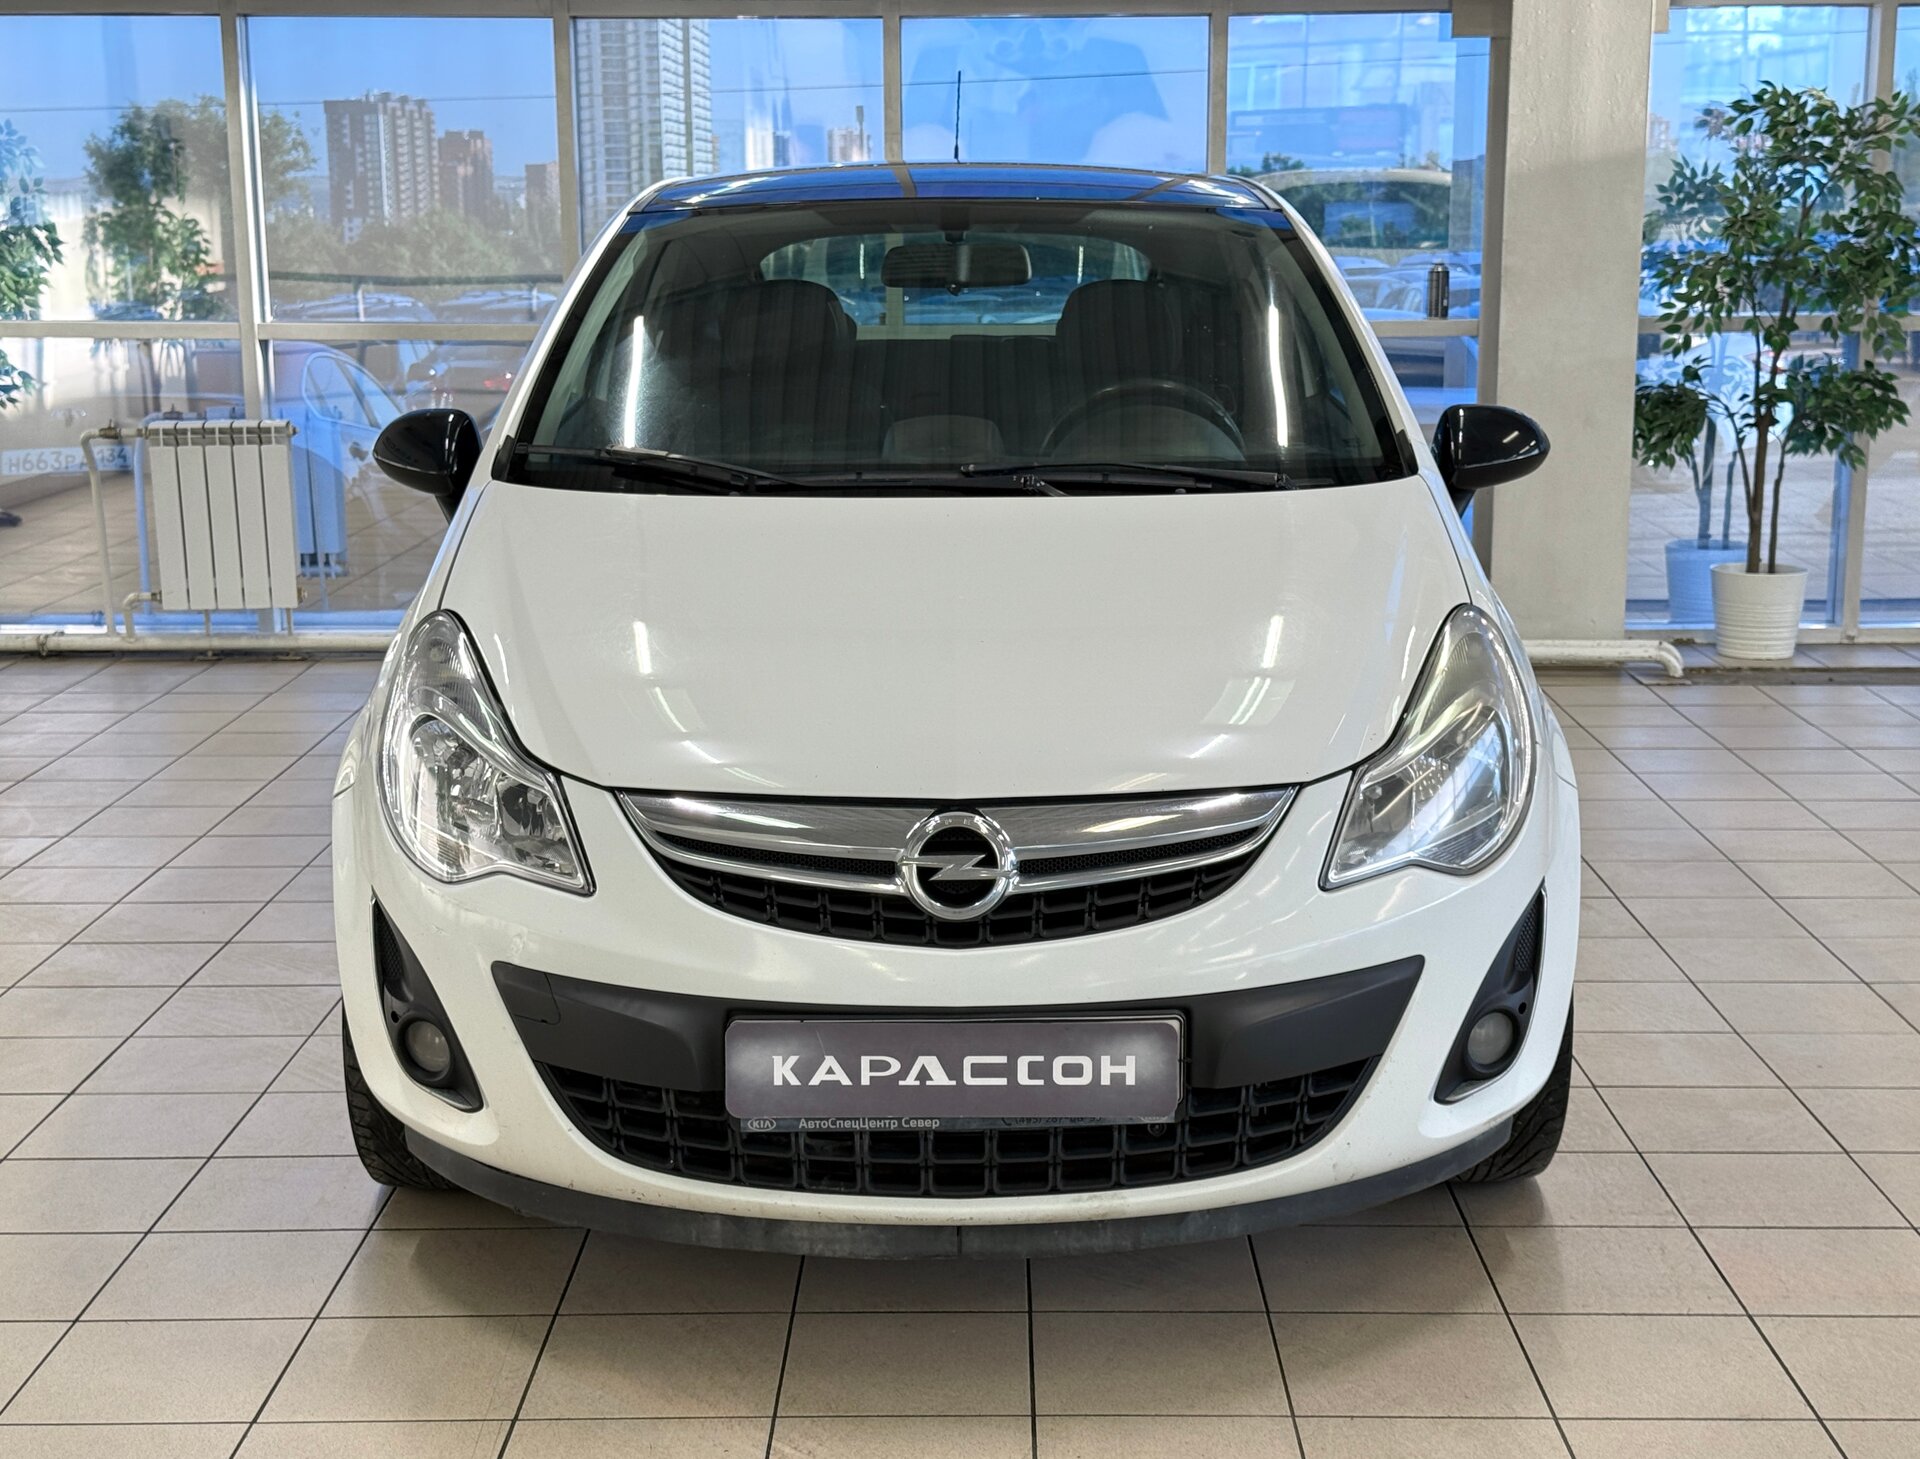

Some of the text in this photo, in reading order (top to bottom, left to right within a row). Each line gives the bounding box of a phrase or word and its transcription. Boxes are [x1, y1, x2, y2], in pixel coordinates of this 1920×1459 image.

[96, 447, 128, 464] 134
[798, 1116, 940, 1130] АвтоСпецЦентр Север
